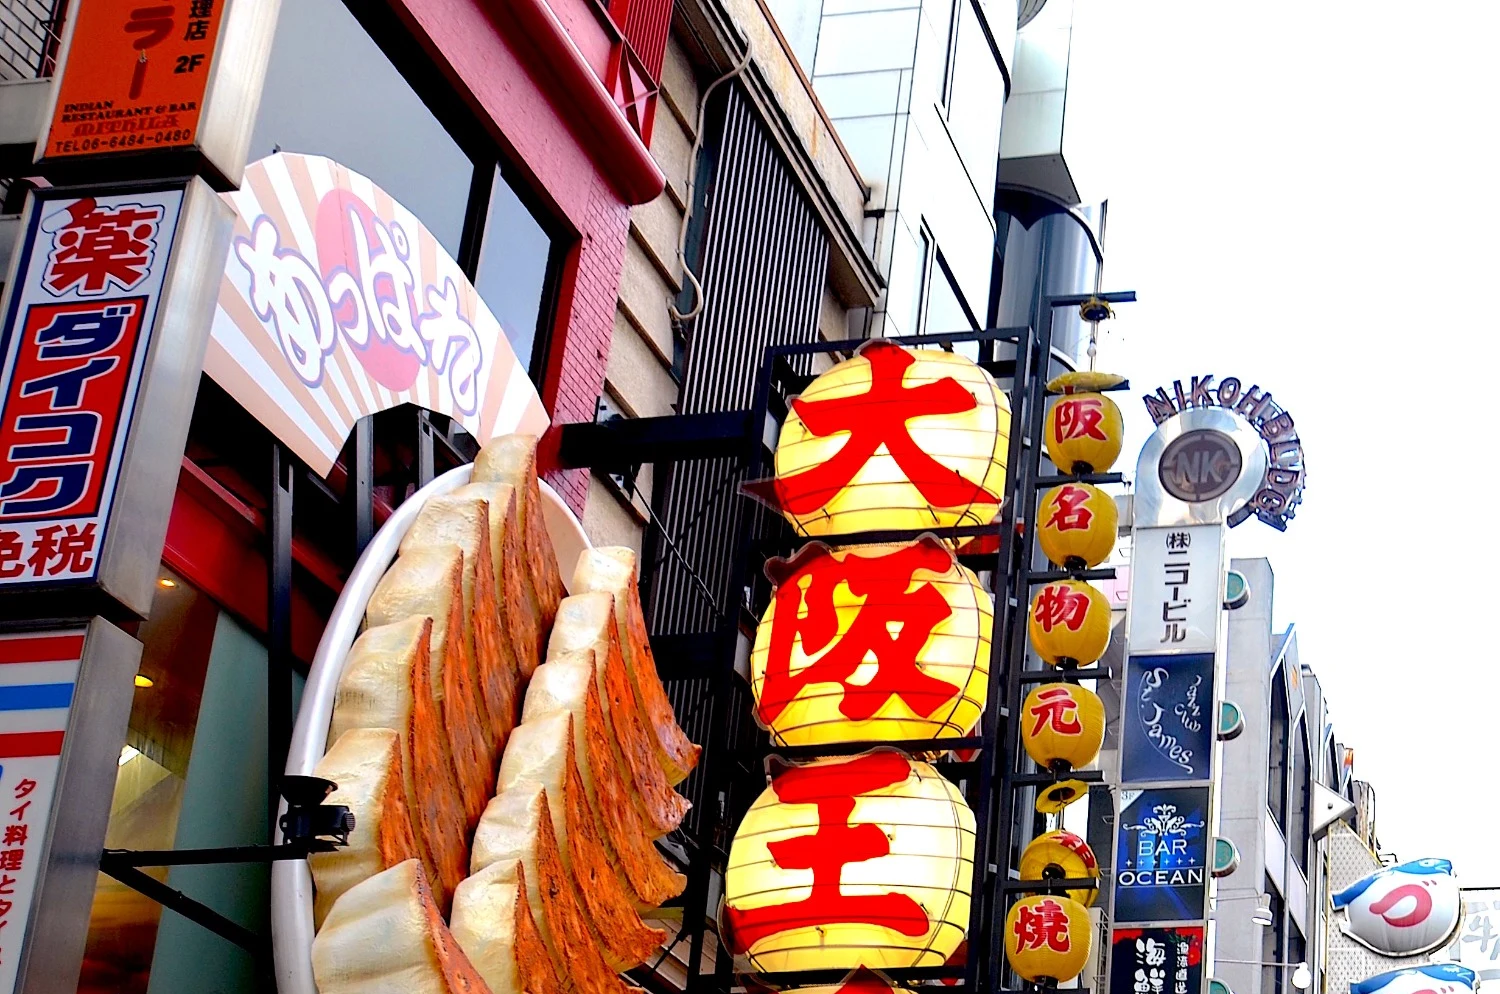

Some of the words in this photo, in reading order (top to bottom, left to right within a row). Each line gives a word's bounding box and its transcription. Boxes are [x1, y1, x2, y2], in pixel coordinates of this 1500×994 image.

[173, 53, 206, 74] 2F
[61, 107, 151, 123] RESTAURANT
[168, 101, 197, 114] BAR
[63, 100, 113, 113] INDIAN
[50, 198, 160, 294] 薬
[2, 304, 138, 517] ダイコク
[1142, 374, 1273, 428] NIKOH
[1174, 450, 1228, 484] NK
[1138, 837, 1188, 858] BAR
[1117, 867, 1205, 887] OCEAN
